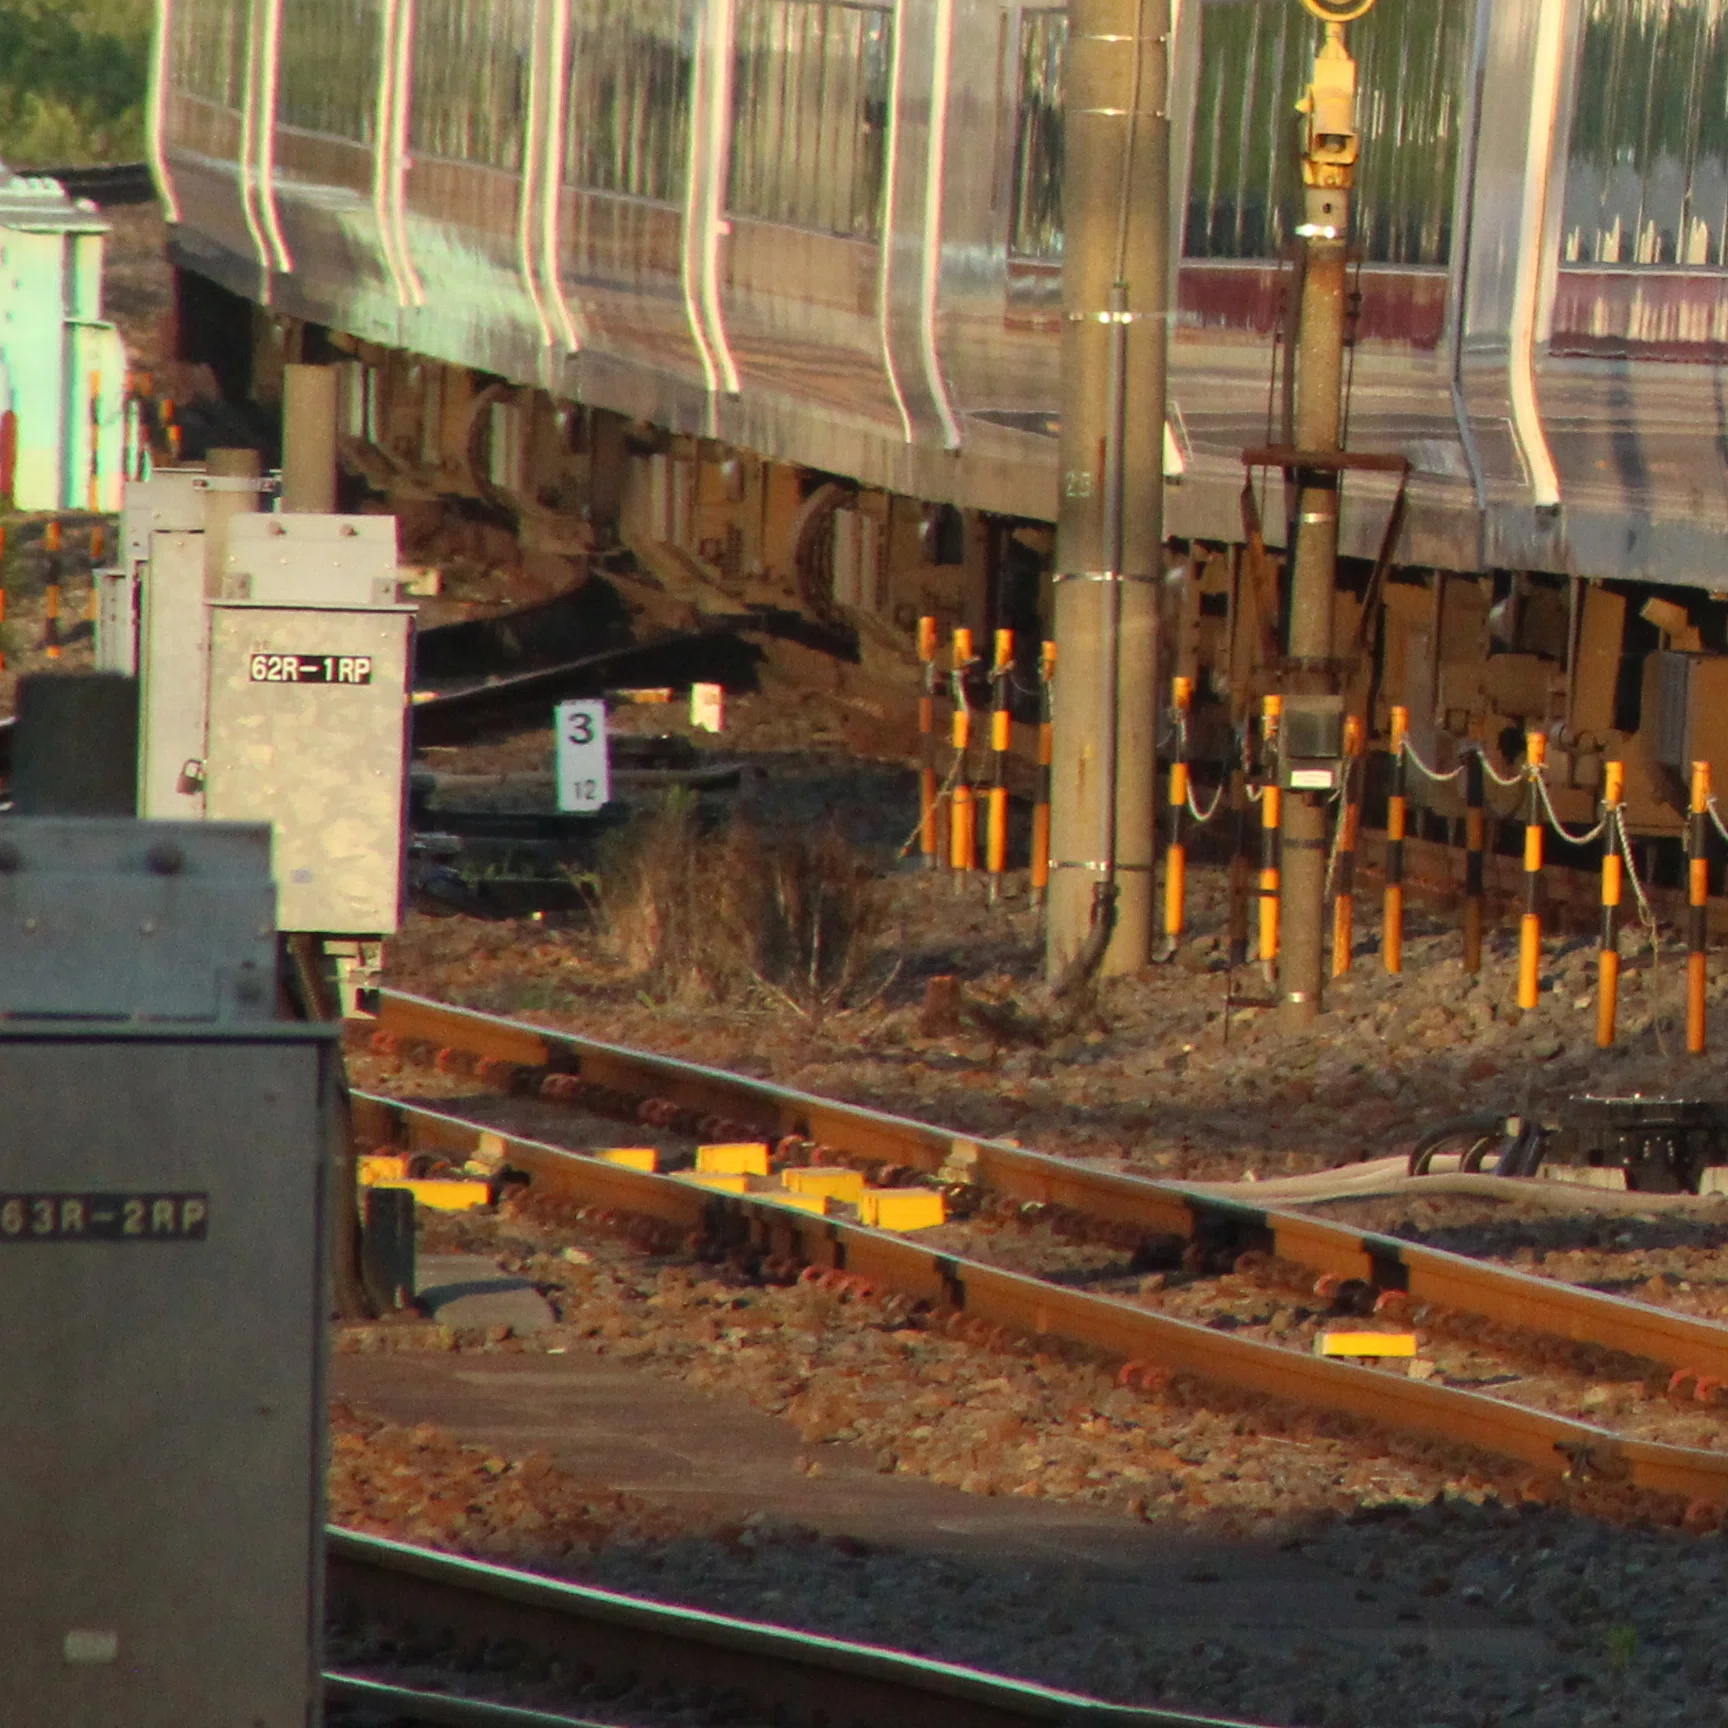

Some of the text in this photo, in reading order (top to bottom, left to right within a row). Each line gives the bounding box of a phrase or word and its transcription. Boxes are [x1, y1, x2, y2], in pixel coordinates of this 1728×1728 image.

[251, 656, 371, 683] 62R-1RP
[568, 713, 595, 745] 3
[573, 779, 596, 801] 12
[1, 1198, 206, 1234] 63R-2RP
